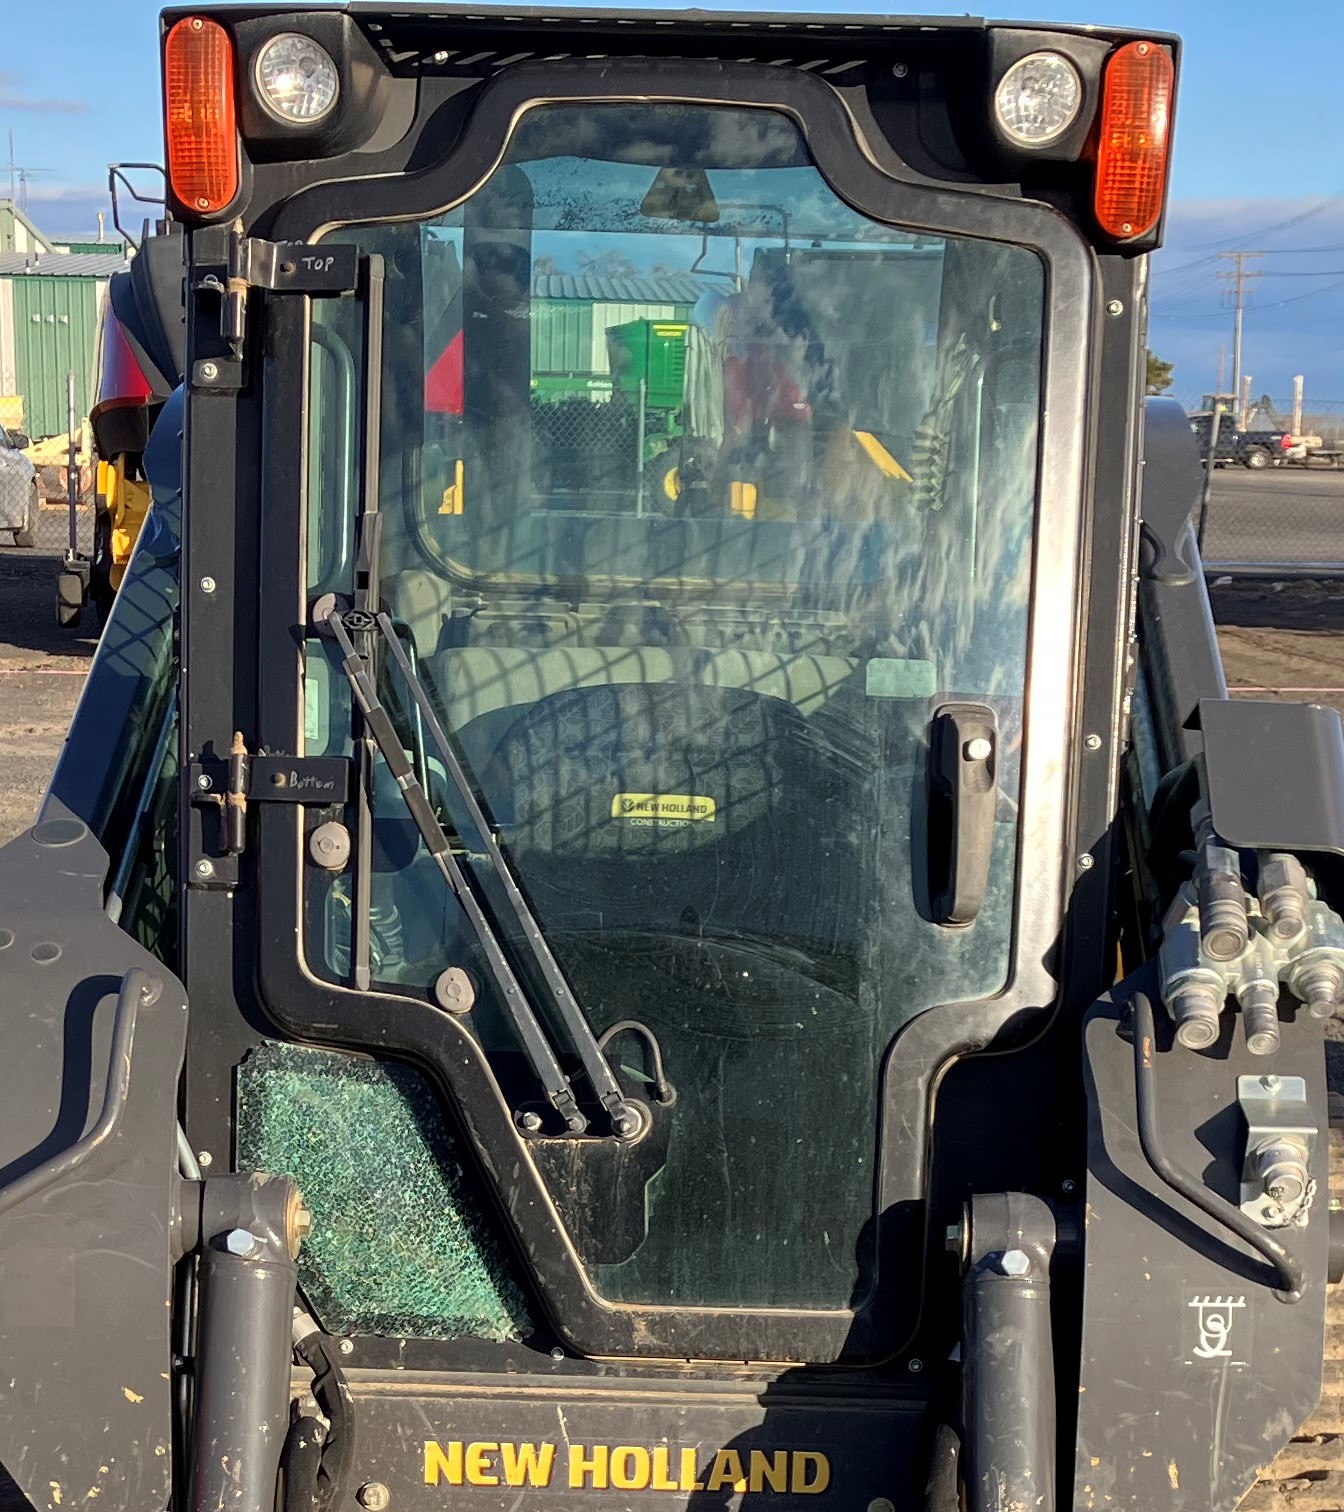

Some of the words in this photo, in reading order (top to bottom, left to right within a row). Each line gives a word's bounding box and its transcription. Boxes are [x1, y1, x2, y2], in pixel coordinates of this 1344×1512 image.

[301, 256, 335, 272] TOP
[636, 802, 659, 812] NEW
[661, 803, 708, 814] HOLLAND
[629, 818, 696, 828] CONSRUCTIO
[423, 1440, 555, 1488] NEW
[568, 1443, 831, 1495] HOLLAND
